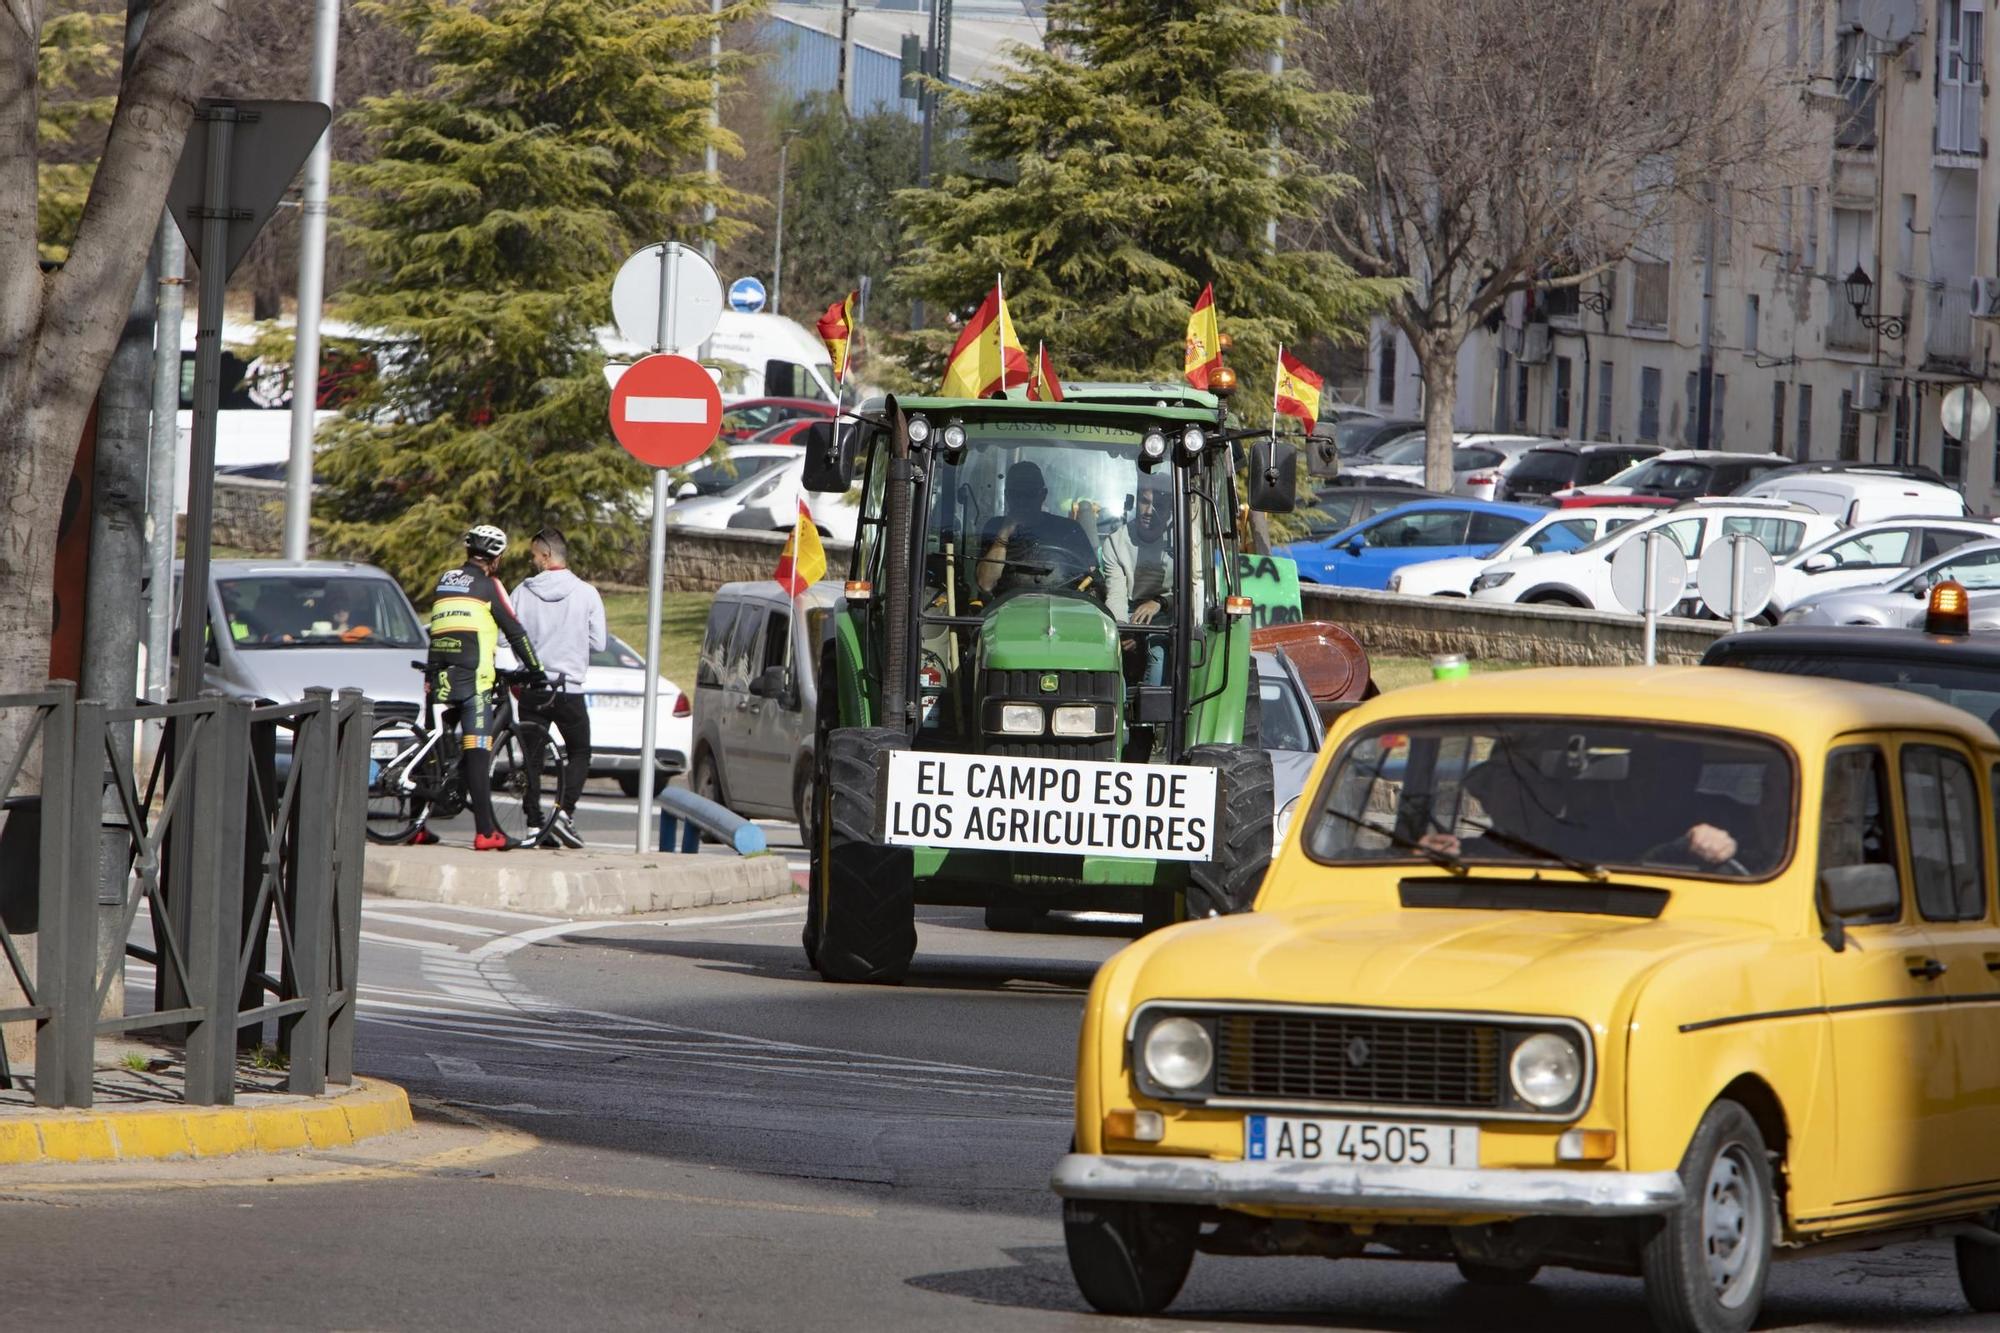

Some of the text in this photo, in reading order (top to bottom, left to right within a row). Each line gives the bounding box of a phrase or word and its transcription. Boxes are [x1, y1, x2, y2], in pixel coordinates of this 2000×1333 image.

[995, 420, 1057, 432] CASAS
[917, 760, 1188, 809] EL CAMPO ES DE
[893, 801, 1207, 852] LOS AGRICULTORES
[1276, 1121, 1322, 1159] AB
[1337, 1125, 1430, 1164] 4505
